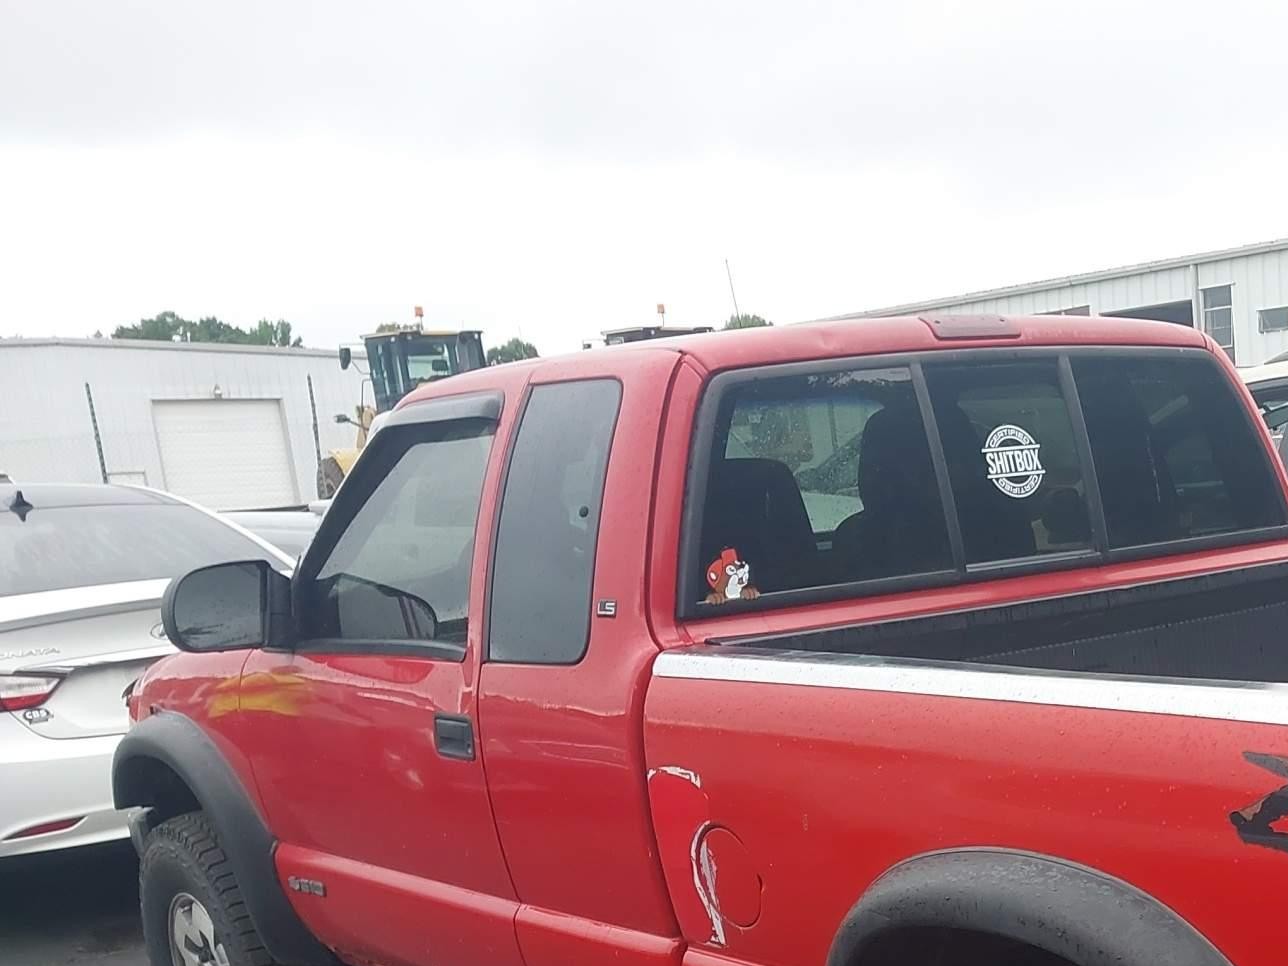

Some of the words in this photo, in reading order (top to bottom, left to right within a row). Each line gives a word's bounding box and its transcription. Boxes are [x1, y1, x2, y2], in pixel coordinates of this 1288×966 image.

[989, 428, 1030, 448] CERTIFIED
[985, 449, 1042, 474] SHITBOX
[998, 474, 1039, 495] CERTIFIED
[597, 602, 616, 616] LS
